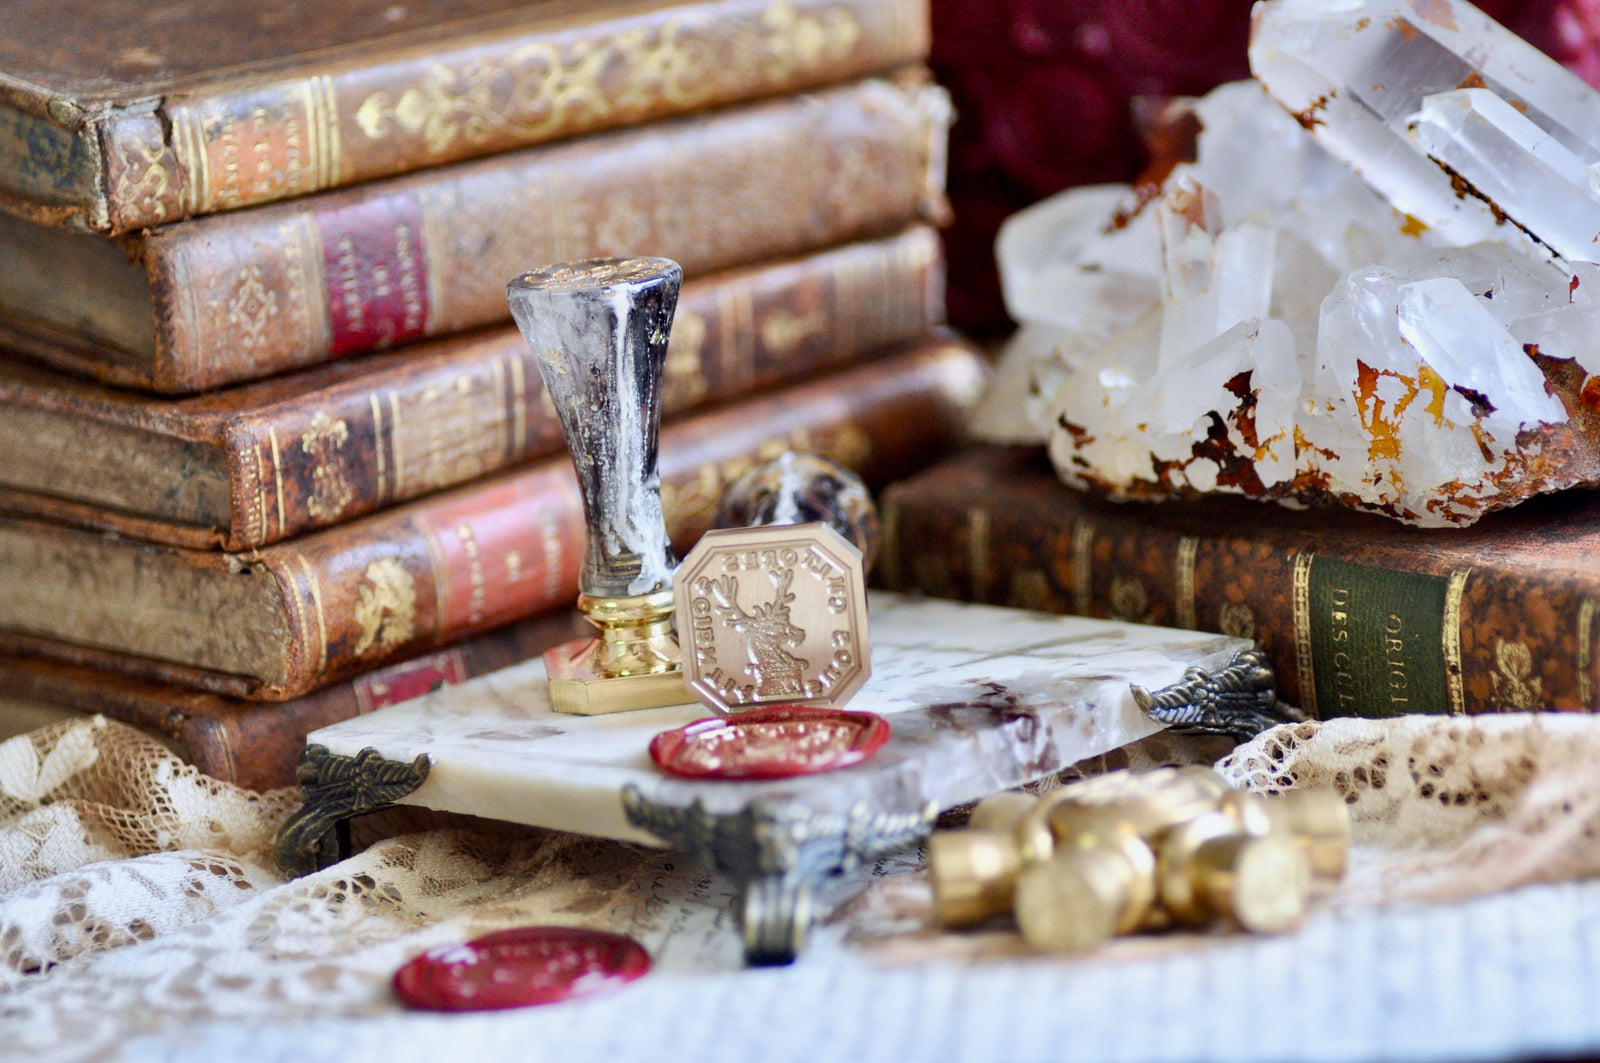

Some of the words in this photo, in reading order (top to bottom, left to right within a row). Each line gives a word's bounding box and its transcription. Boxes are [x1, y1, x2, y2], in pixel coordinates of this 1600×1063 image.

[1331, 588, 1349, 643] DES
[1334, 652, 1358, 717] CUL
[1384, 613, 1409, 715] ORIGI
